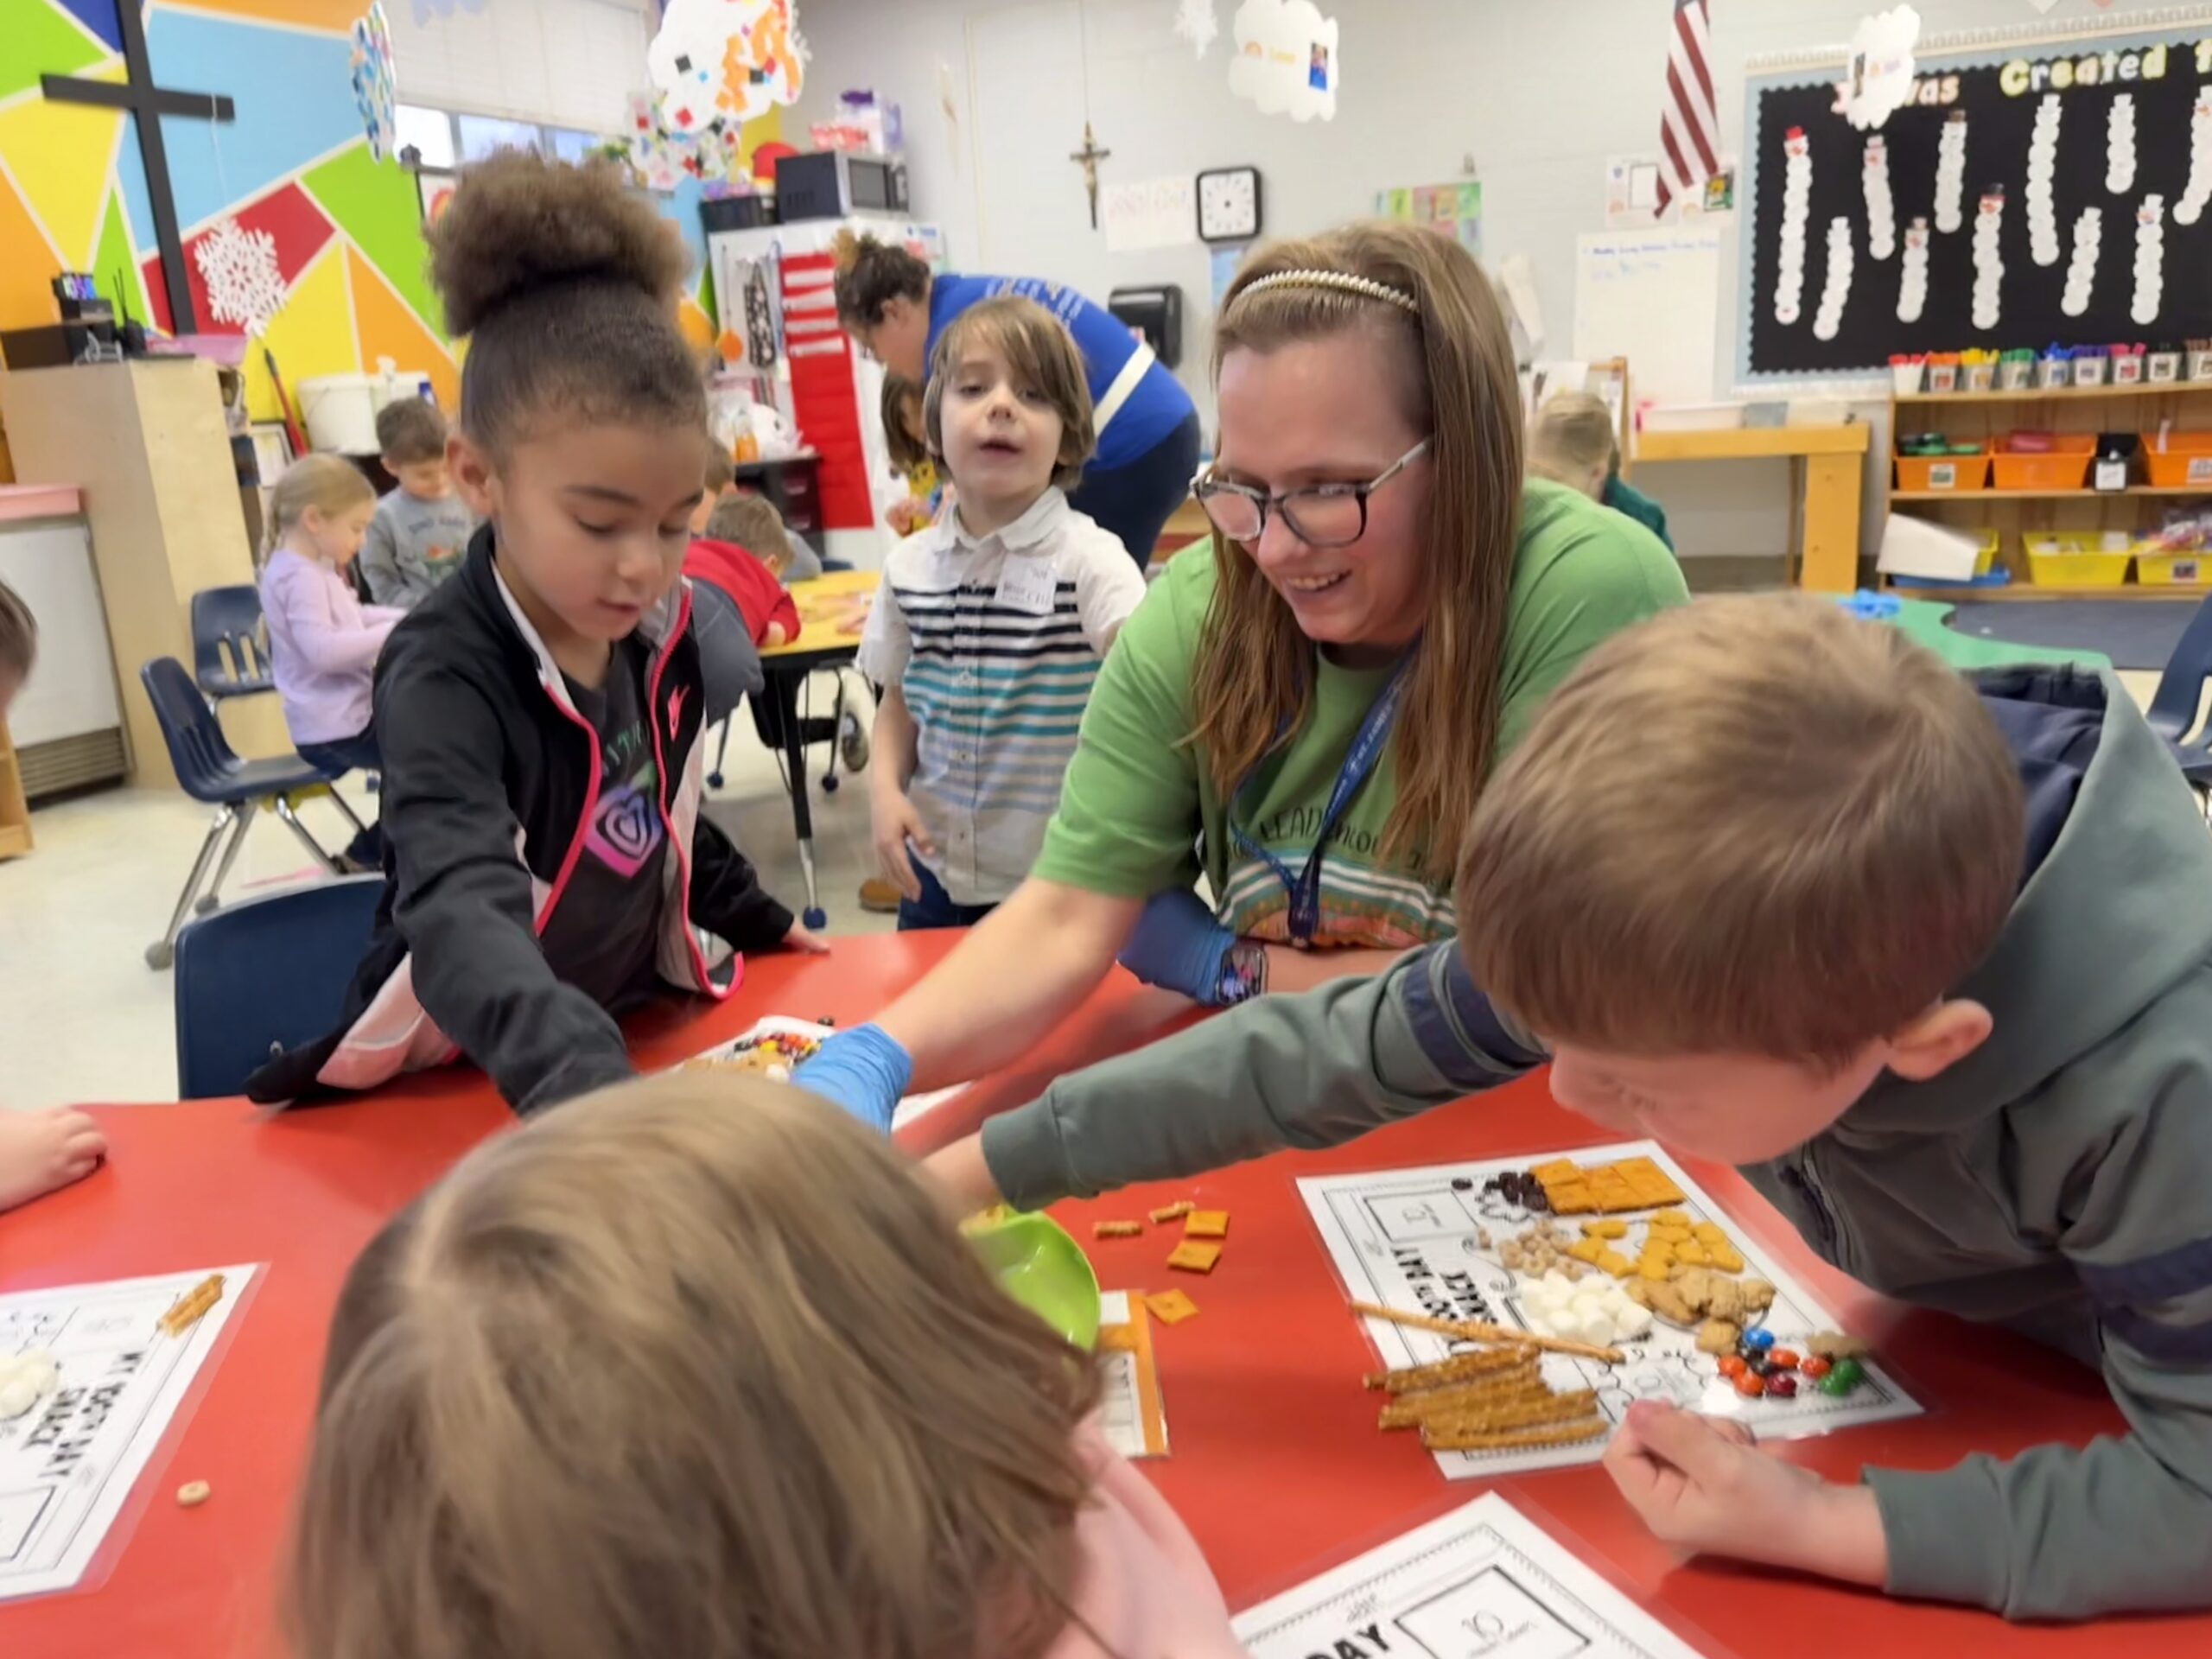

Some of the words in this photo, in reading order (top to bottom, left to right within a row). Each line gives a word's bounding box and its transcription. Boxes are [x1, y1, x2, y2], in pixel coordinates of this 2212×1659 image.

[1905, 74, 1960, 107] as
[1999, 43, 2167, 97] Created
[1390, 1245, 1435, 1282] DAY
